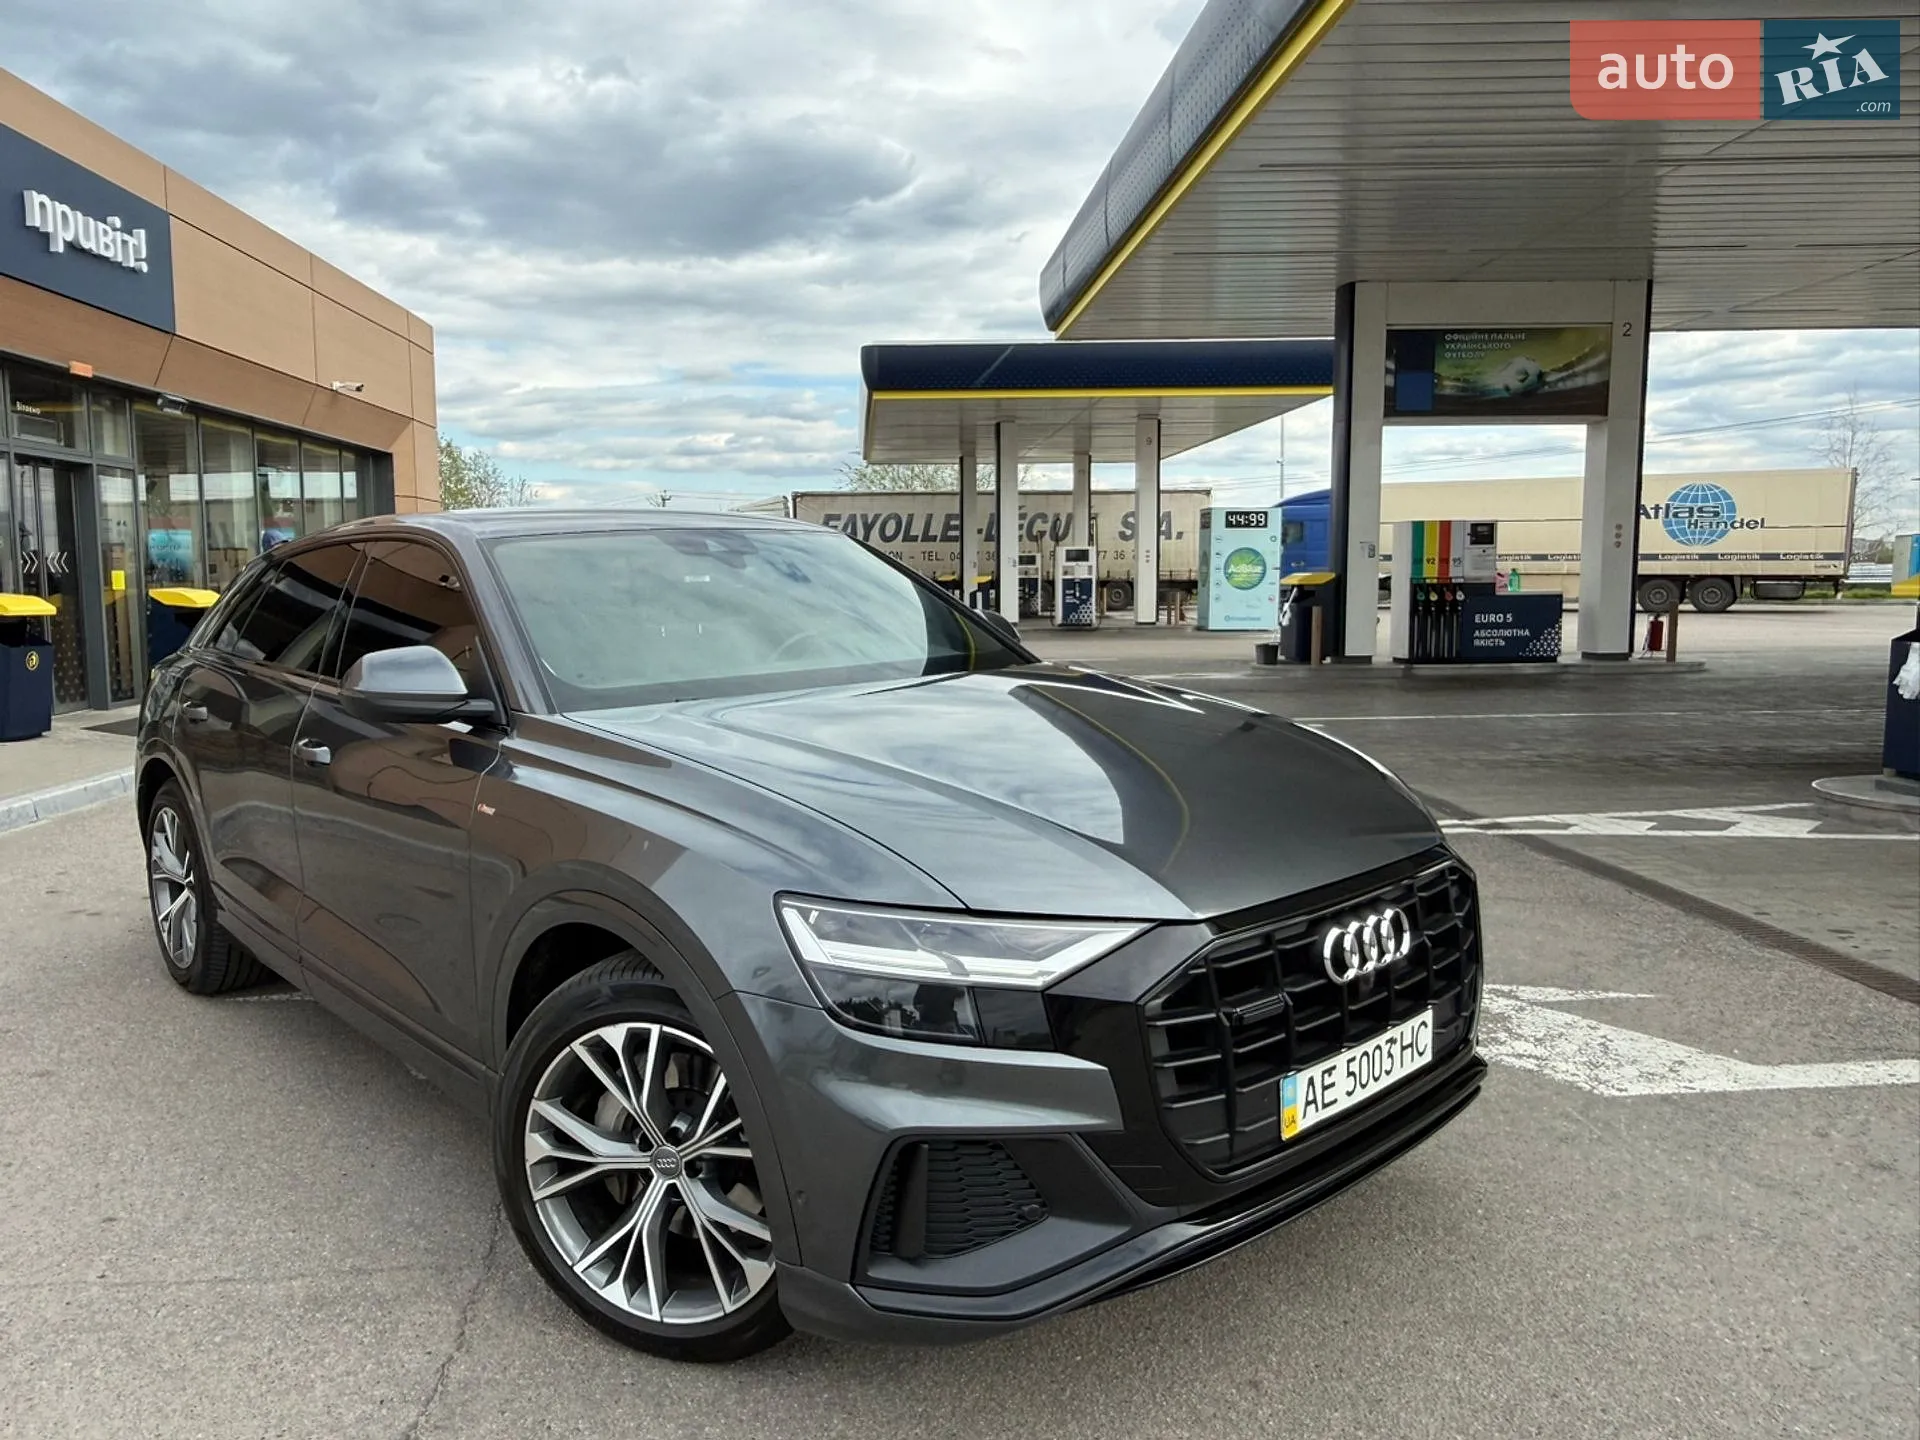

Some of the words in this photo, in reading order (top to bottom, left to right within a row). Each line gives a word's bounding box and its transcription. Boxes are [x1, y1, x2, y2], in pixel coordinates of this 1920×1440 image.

[23, 190, 148, 273] привіт!
[1622, 322, 1632, 337] 2
[1638, 503, 1720, 520] Atlas
[1227, 513, 1266, 527] 44:99
[1687, 517, 1765, 531] Handel
[1658, 552, 1699, 561] Logistik
[1718, 552, 1760, 561] Logistik
[1779, 552, 1825, 560] Logistik
[1474, 613, 1503, 623] EURO
[1506, 613, 1513, 623] 5
[1473, 629, 1530, 638] АБСОЛЮТНА
[1473, 638, 1505, 647] ЯКІСТЬ
[1302, 1064, 1338, 1120] AE
[1345, 1036, 1398, 1098] 5003
[1400, 1019, 1428, 1069] HC
[1285, 1114, 1297, 1129] UA
